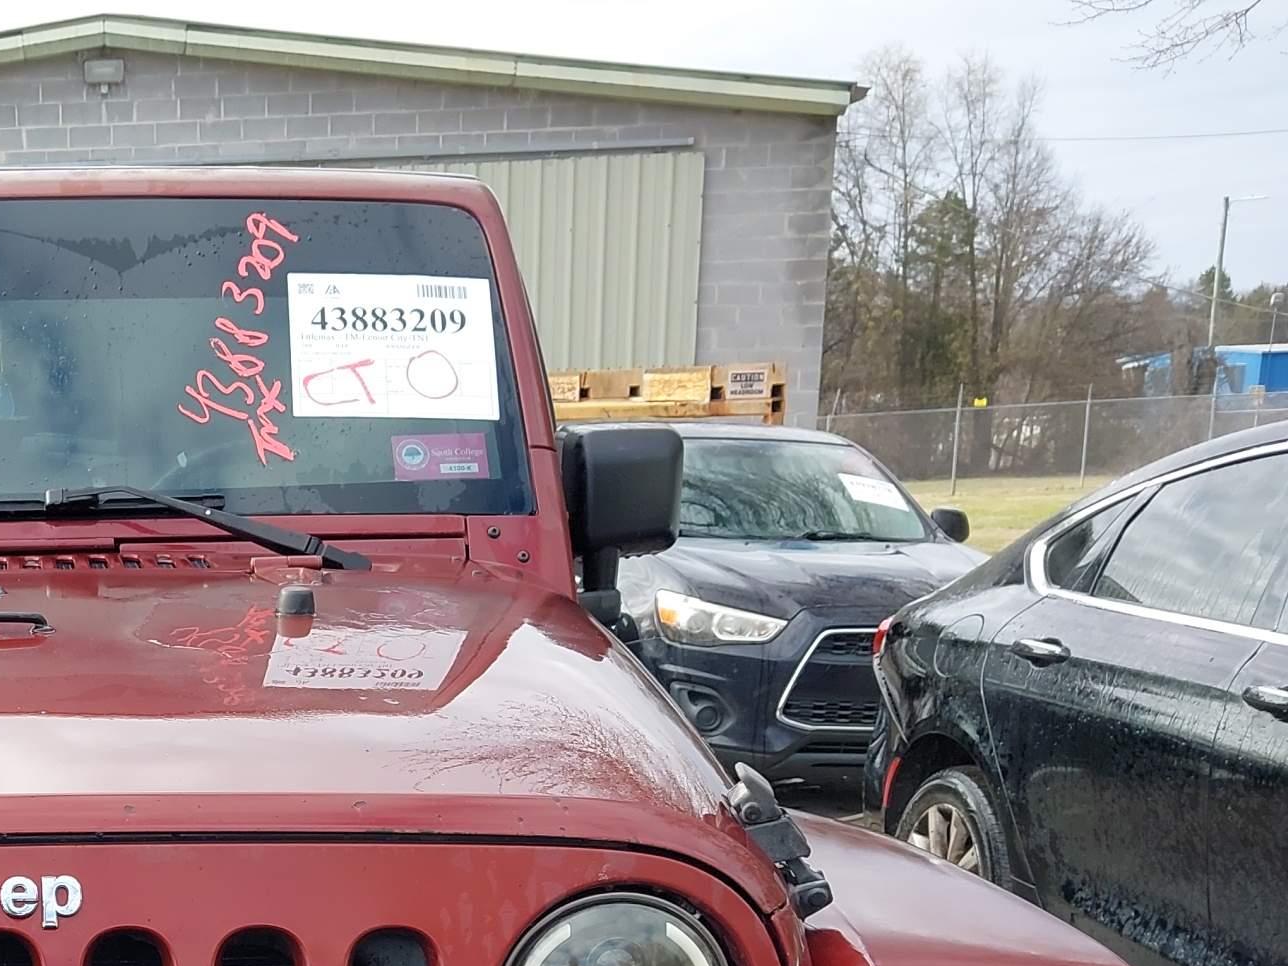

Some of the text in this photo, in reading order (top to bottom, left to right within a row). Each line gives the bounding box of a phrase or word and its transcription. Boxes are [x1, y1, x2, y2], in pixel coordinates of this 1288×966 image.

[177, 212, 299, 424] 43883209
[311, 306, 467, 334] 43883209
[731, 373, 765, 382] CAUTION
